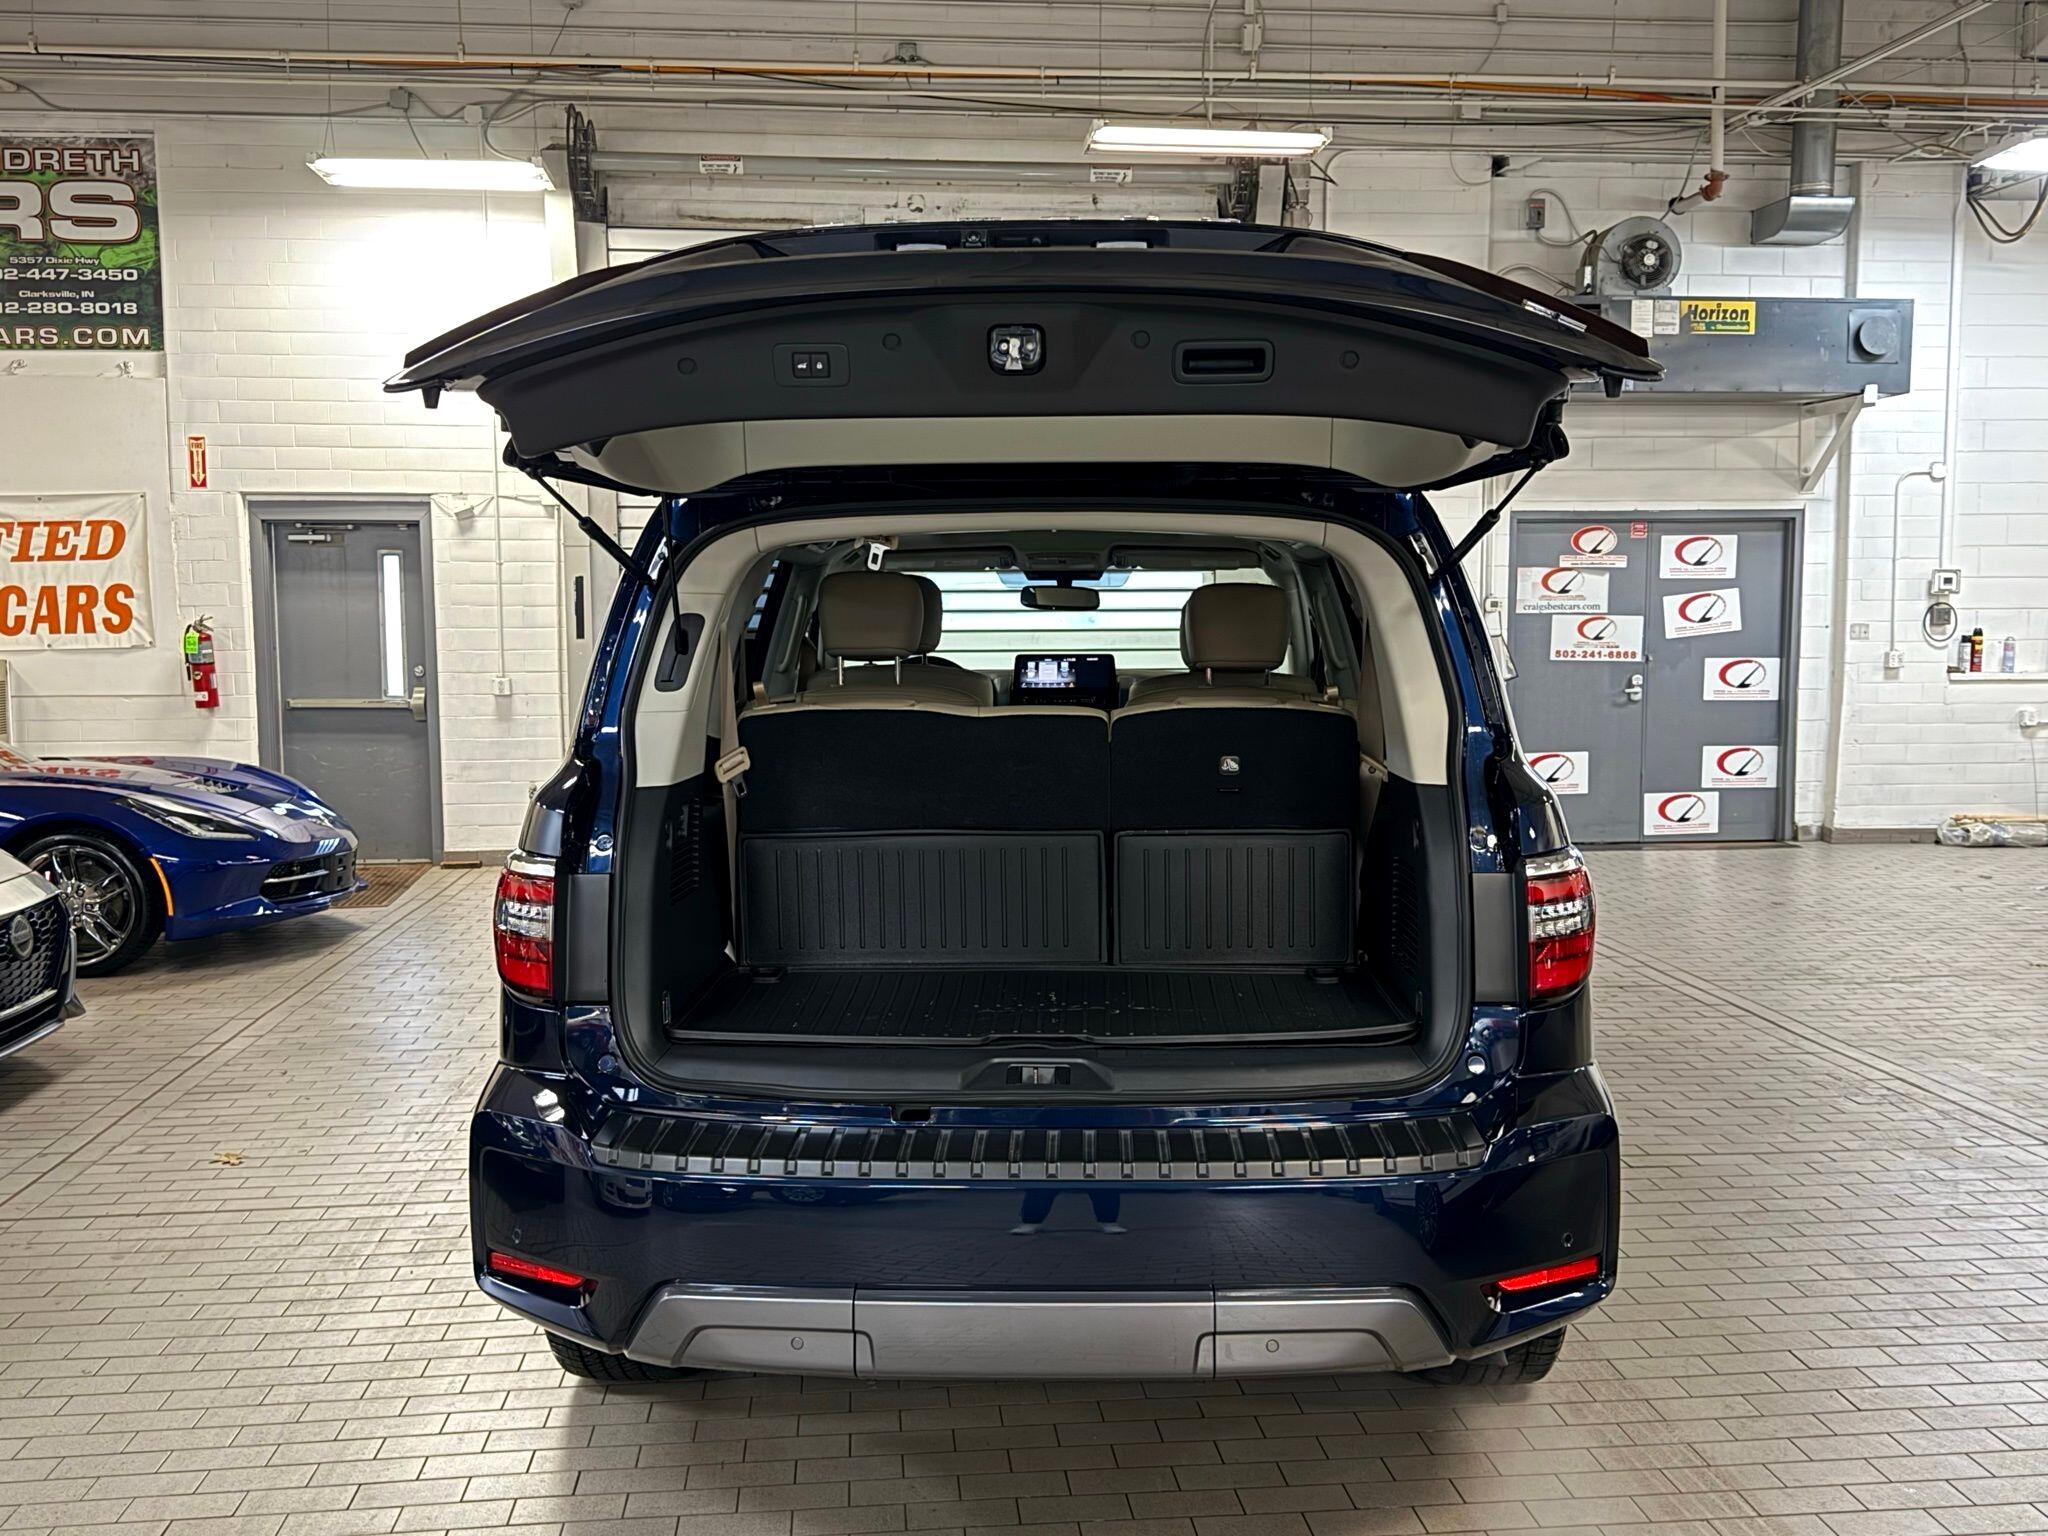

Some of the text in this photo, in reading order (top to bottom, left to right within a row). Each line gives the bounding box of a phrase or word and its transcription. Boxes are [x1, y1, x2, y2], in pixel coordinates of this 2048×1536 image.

[9, 256, 99, 266] 5357 Dixie Hwy
[0, 268, 138, 281] 2-447-3450
[19, 290, 95, 299] Clarksville, IN
[1688, 302, 1750, 321] Horizon
[0, 583, 135, 637] CARS
[1523, 602, 1601, 612] craigsbestcars.com
[1555, 650, 1637, 659] 502-241-6868
